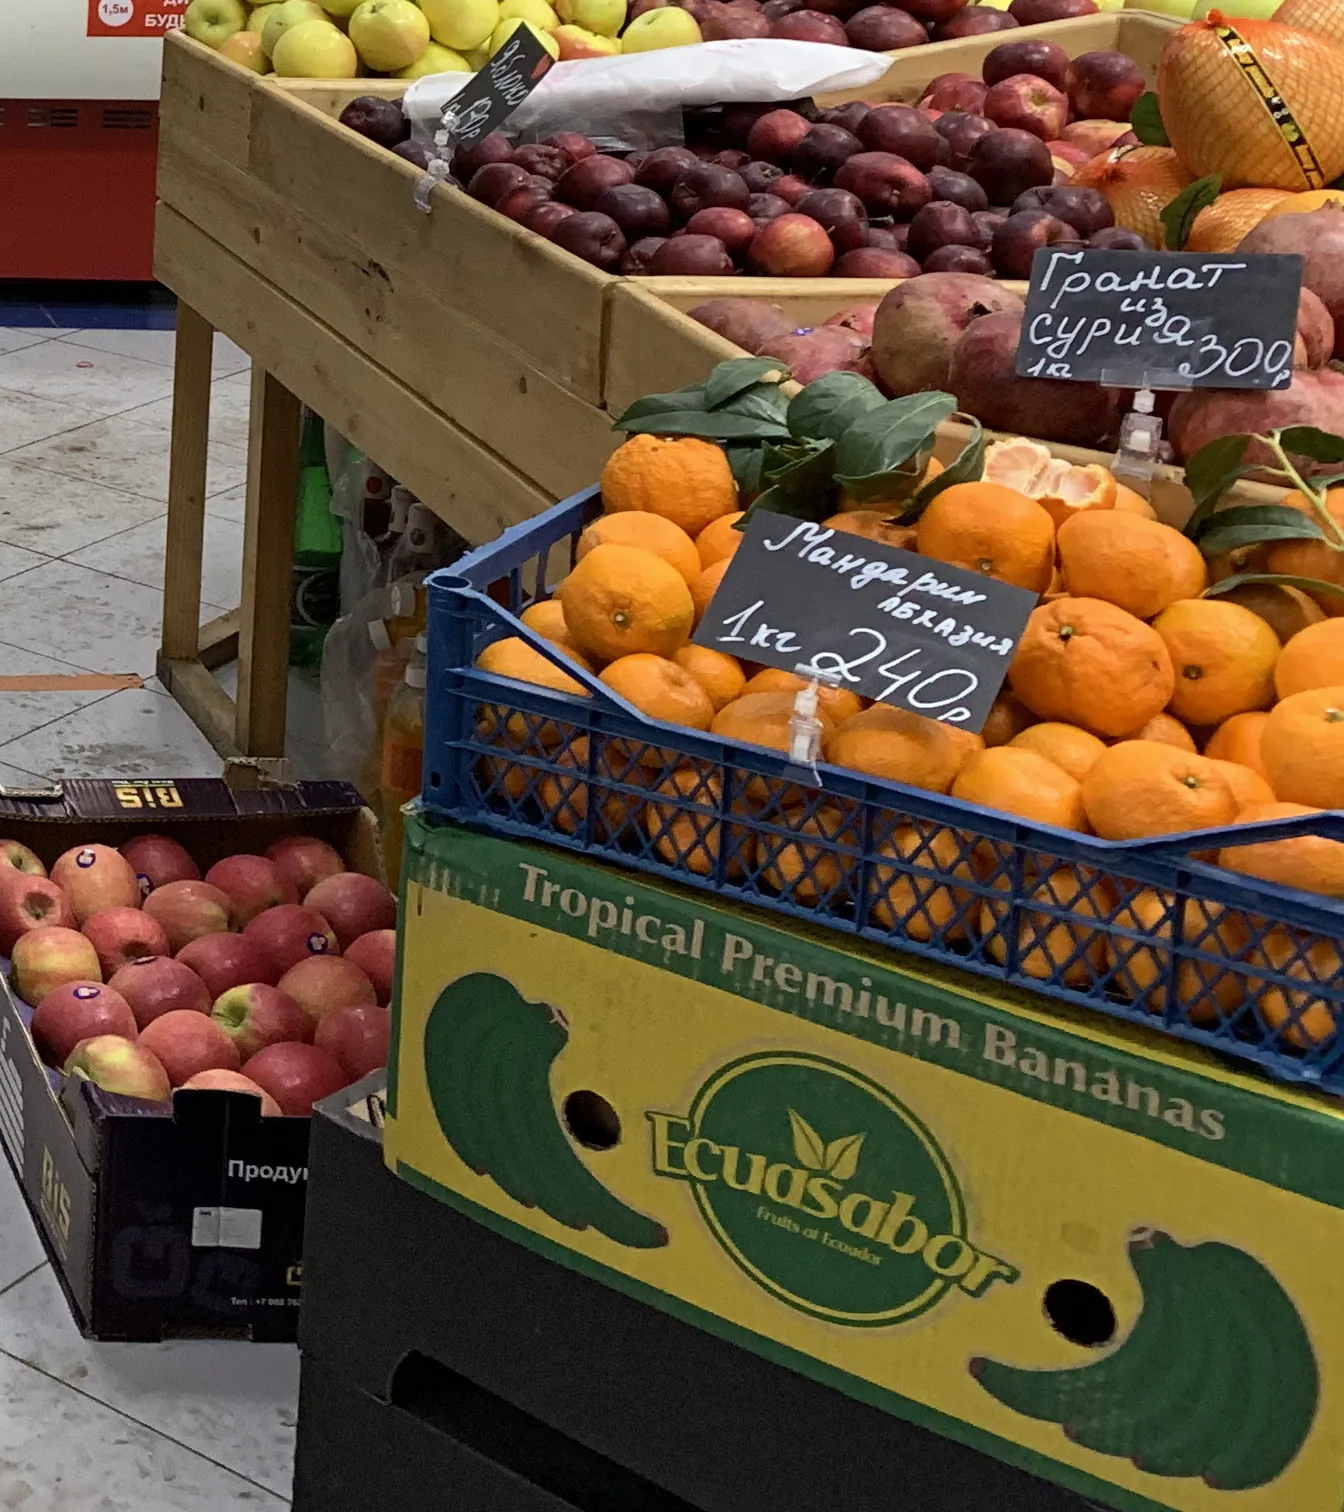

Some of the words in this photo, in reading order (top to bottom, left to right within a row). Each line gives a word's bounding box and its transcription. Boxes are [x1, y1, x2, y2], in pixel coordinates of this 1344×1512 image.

[102, 3, 129, 16] 1,5м
[1039, 250, 1247, 310] Гранат
[1120, 296, 1170, 328] из
[763, 520, 988, 607] Мандарин
[717, 600, 803, 655] 1кг
[516, 862, 705, 962] Tropical
[720, 931, 964, 1051] Premium
[982, 1020, 1229, 1144] Bananas
[645, 1109, 1022, 1298] Ecuasabor
[755, 1204, 802, 1237] Fruits
[820, 1231, 886, 1268] Ecuador
